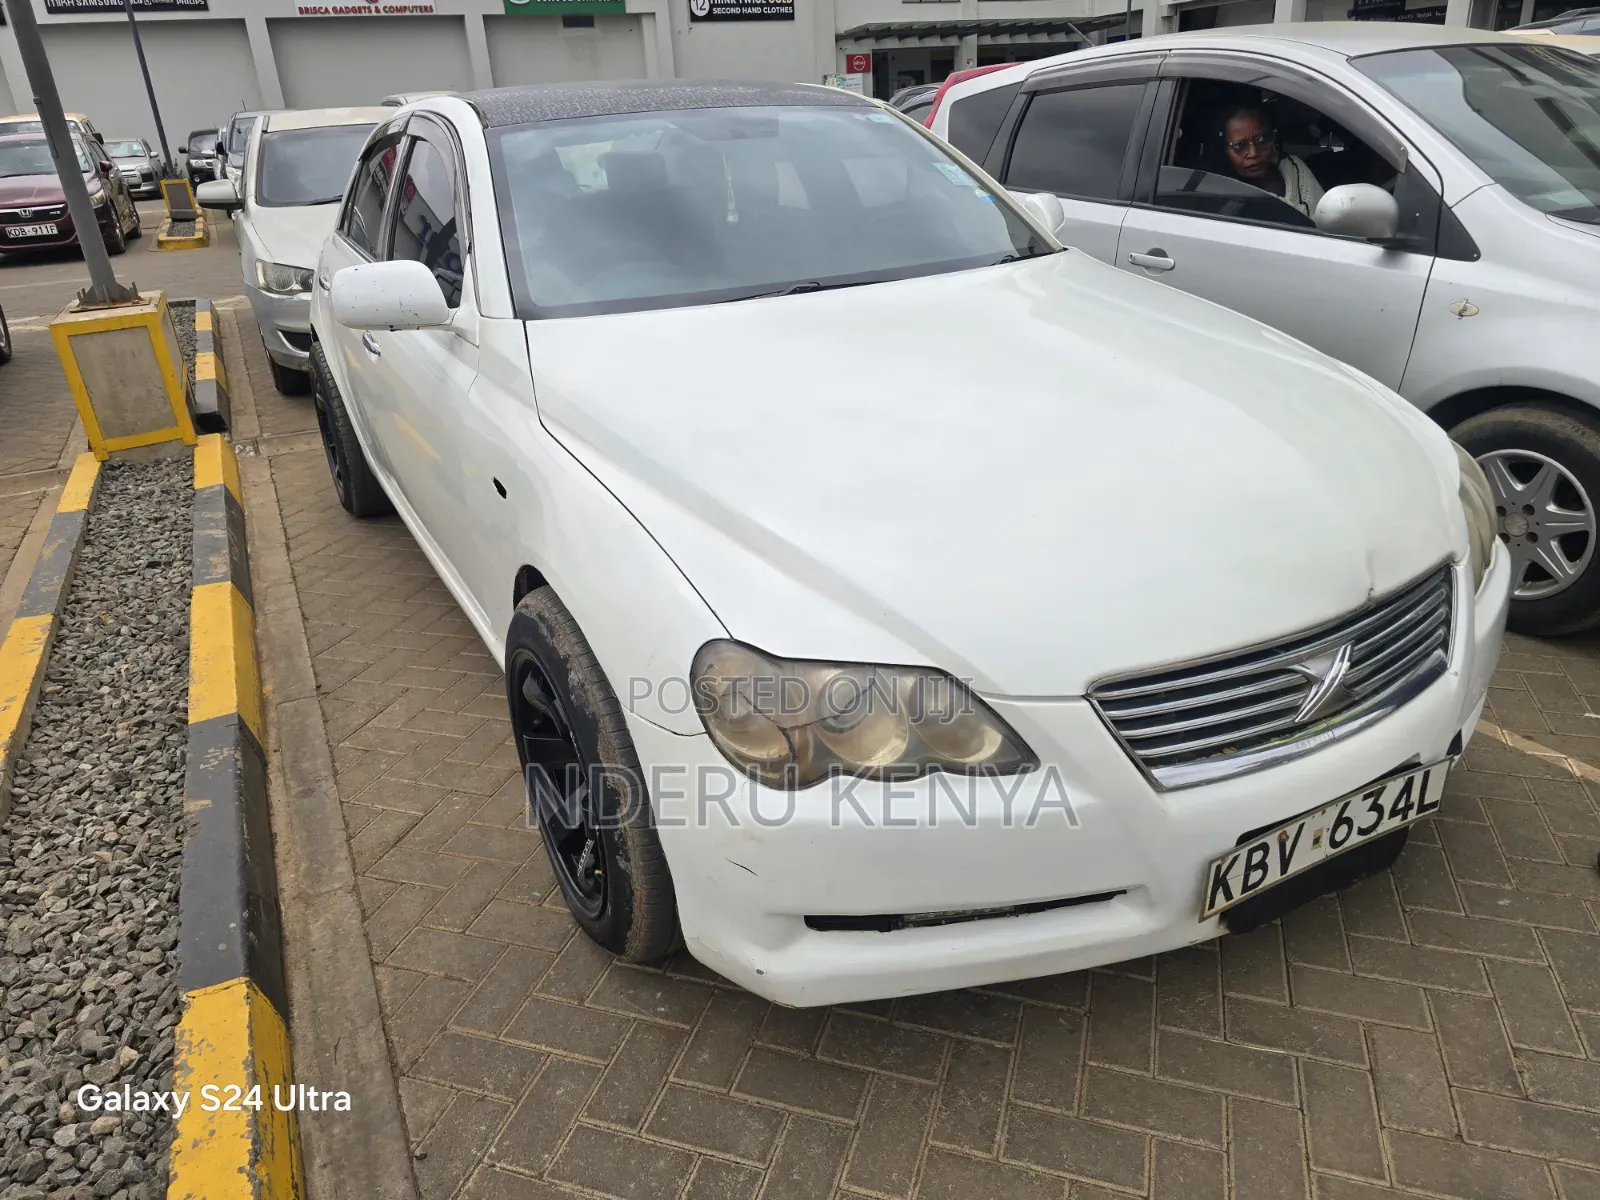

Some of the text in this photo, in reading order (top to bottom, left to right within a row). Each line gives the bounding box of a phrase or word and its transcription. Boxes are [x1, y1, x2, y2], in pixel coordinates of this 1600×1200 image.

[298, 5, 434, 15] BRISCA GADGETS & COMPUTERS
[763, 6, 793, 14] CLOTHES
[8, 225, 56, 238] KDB 911F
[1207, 769, 1440, 911] KBV 634L
